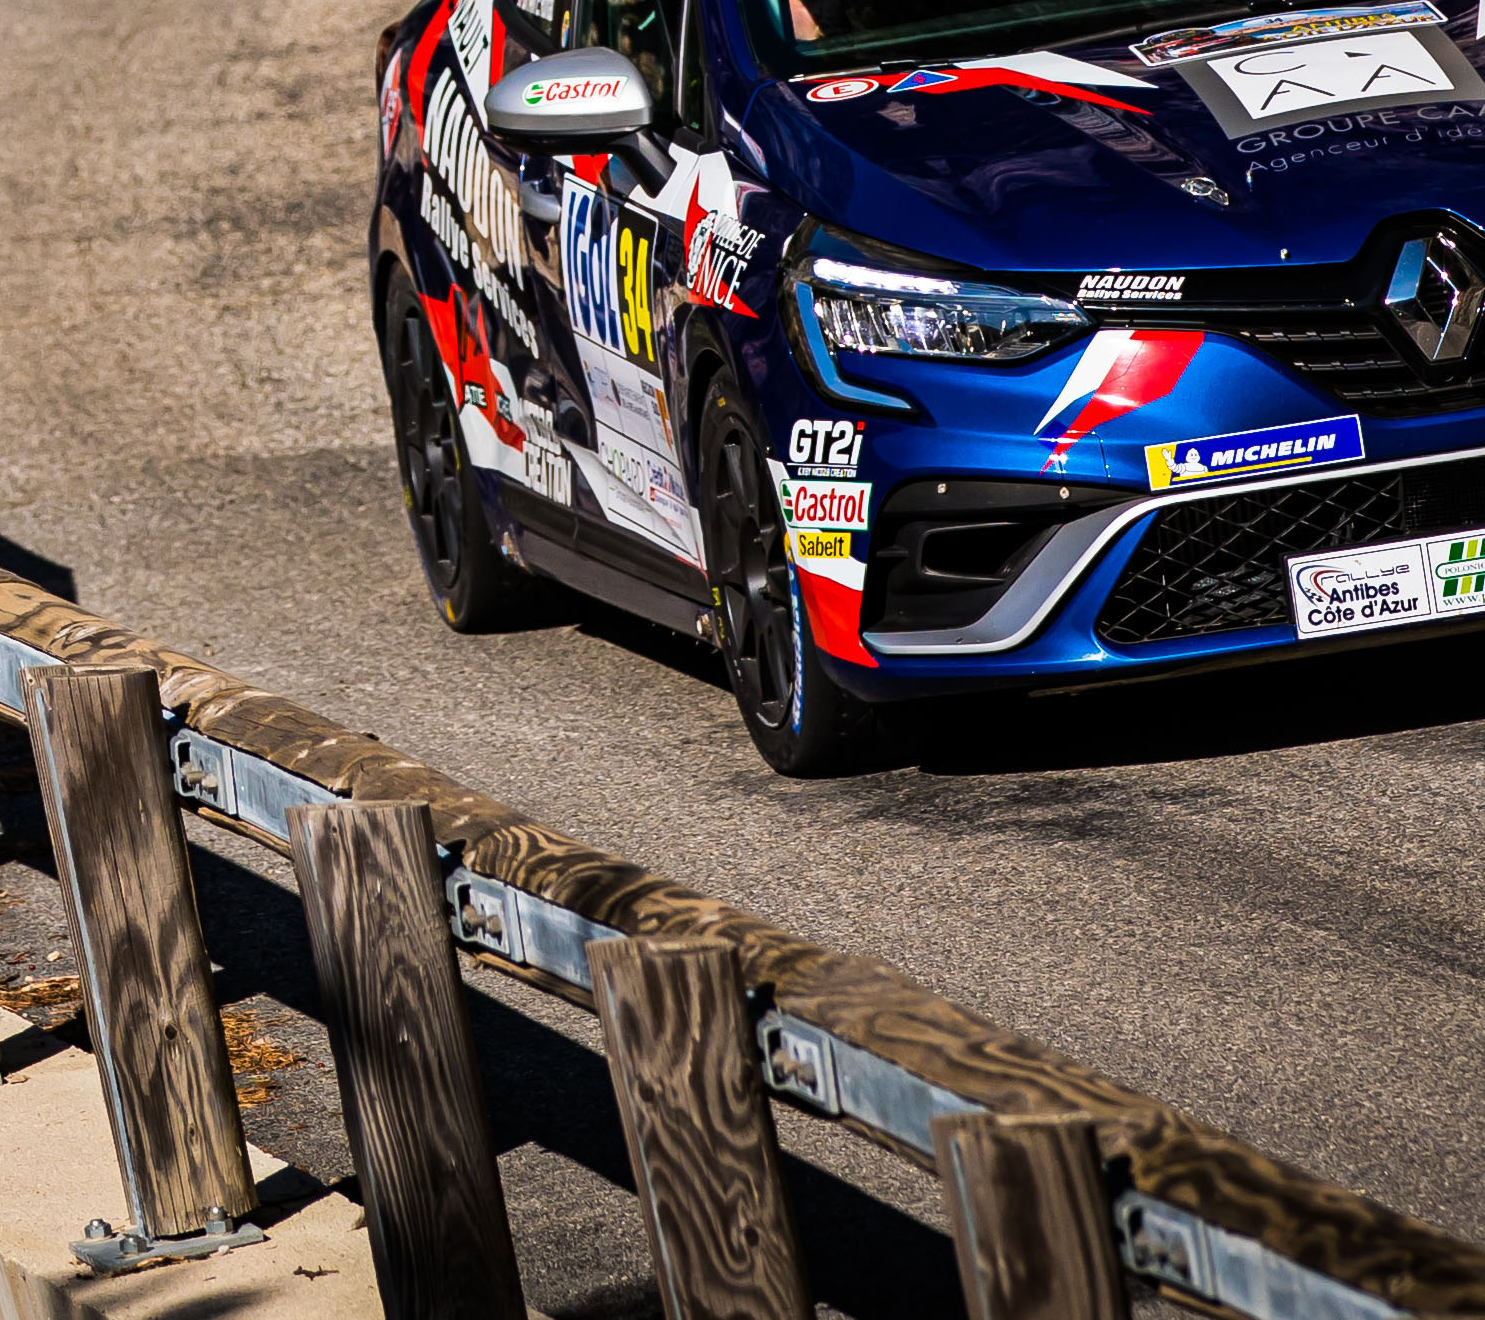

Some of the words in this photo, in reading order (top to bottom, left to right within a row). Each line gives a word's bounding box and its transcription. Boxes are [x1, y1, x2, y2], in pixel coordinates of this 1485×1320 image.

[545, 79, 621, 100] Castrol
[832, 84, 853, 96] E
[1236, 111, 1401, 153] GROUPE
[1249, 136, 1389, 172] Agenceur
[423, 67, 525, 291] NAUDON
[421, 172, 469, 270] Rallye
[472, 242, 540, 359] Services
[696, 247, 748, 311] NICE
[1079, 274, 1186, 290] NAUDON
[619, 227, 655, 363] 34
[1076, 289, 1121, 299] Rallye
[1121, 290, 1183, 300] Services
[789, 419, 866, 465] GT2i
[1211, 434, 1336, 467] MICHELIN
[794, 486, 865, 523] Castrol
[799, 535, 845, 558] Sabelt
[1328, 579, 1400, 605] Antibes
[1308, 602, 1354, 627] Côte
[1361, 596, 1419, 619] d'Azur
